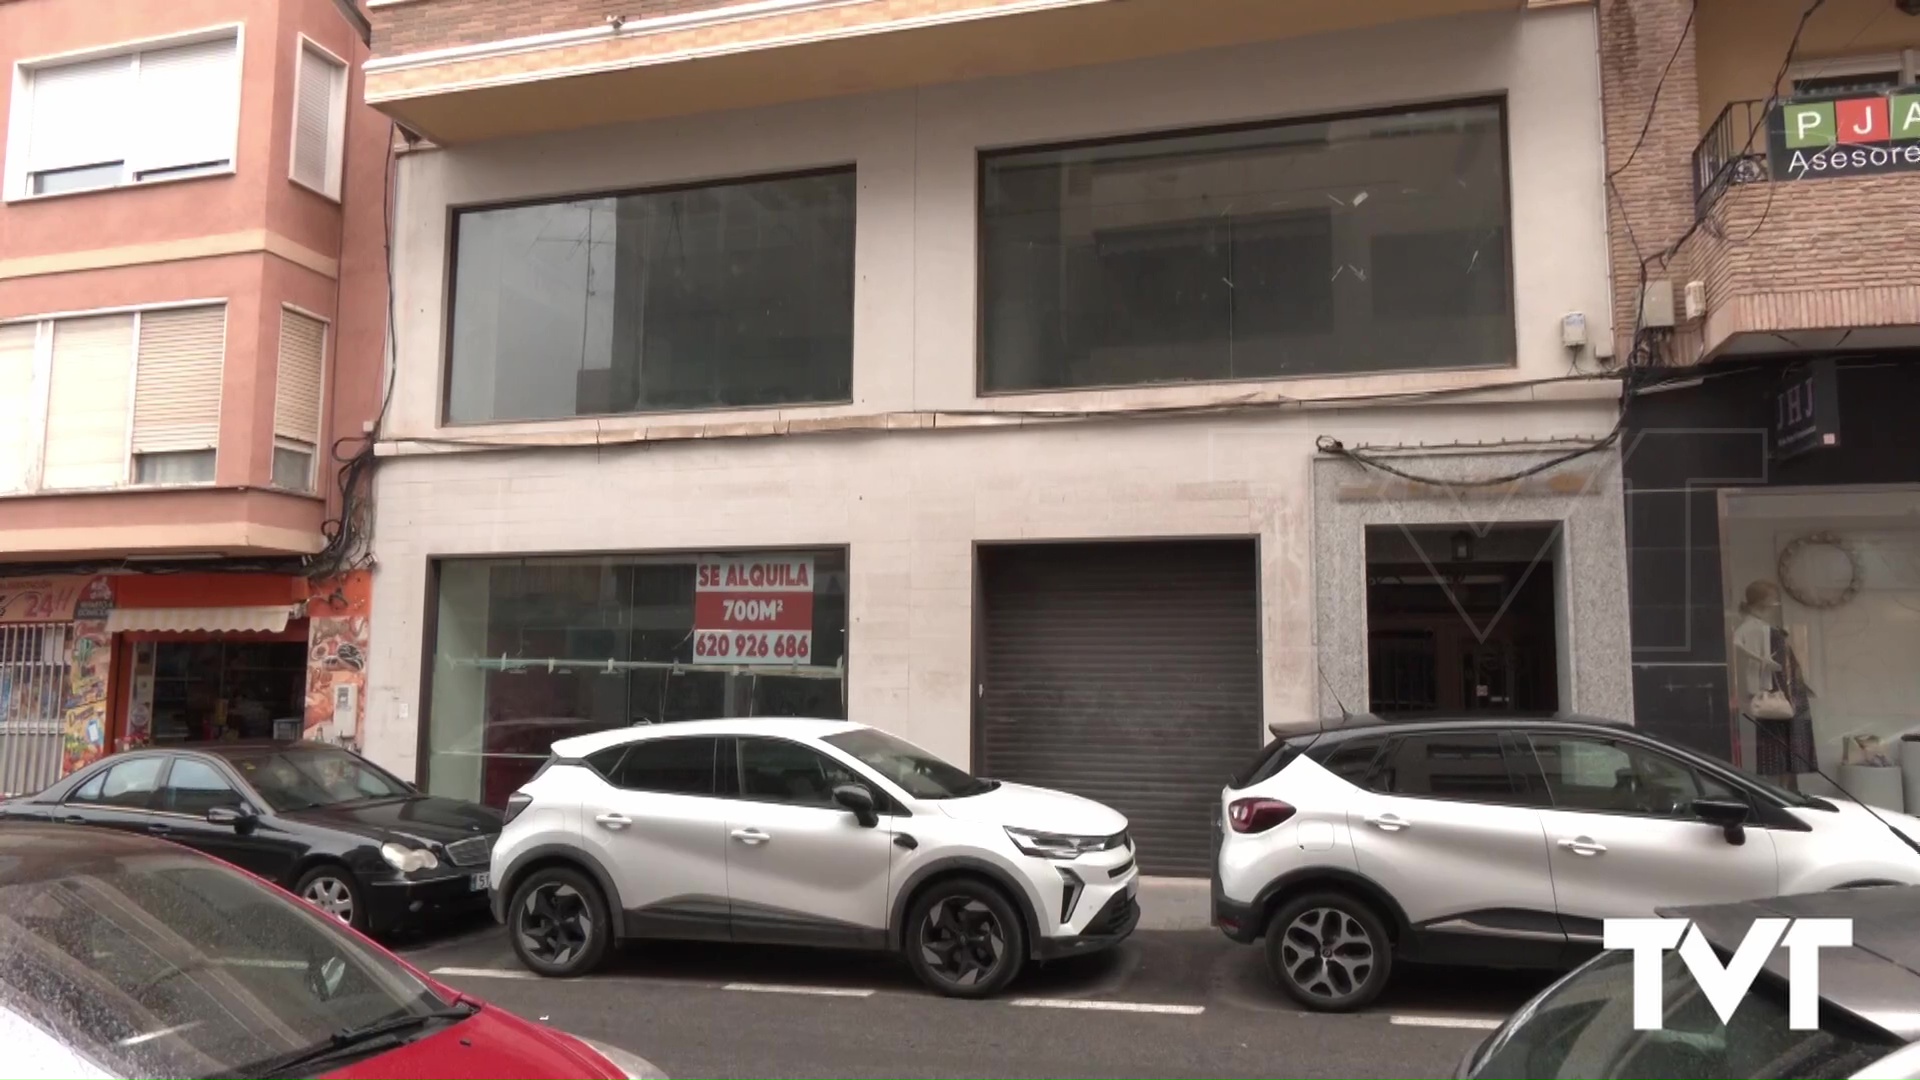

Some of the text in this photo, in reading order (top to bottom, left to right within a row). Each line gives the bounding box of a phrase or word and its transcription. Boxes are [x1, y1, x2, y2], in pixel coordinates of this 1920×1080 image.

[698, 563, 809, 587] SE ALQUILA
[696, 633, 809, 658] 620 926 686
